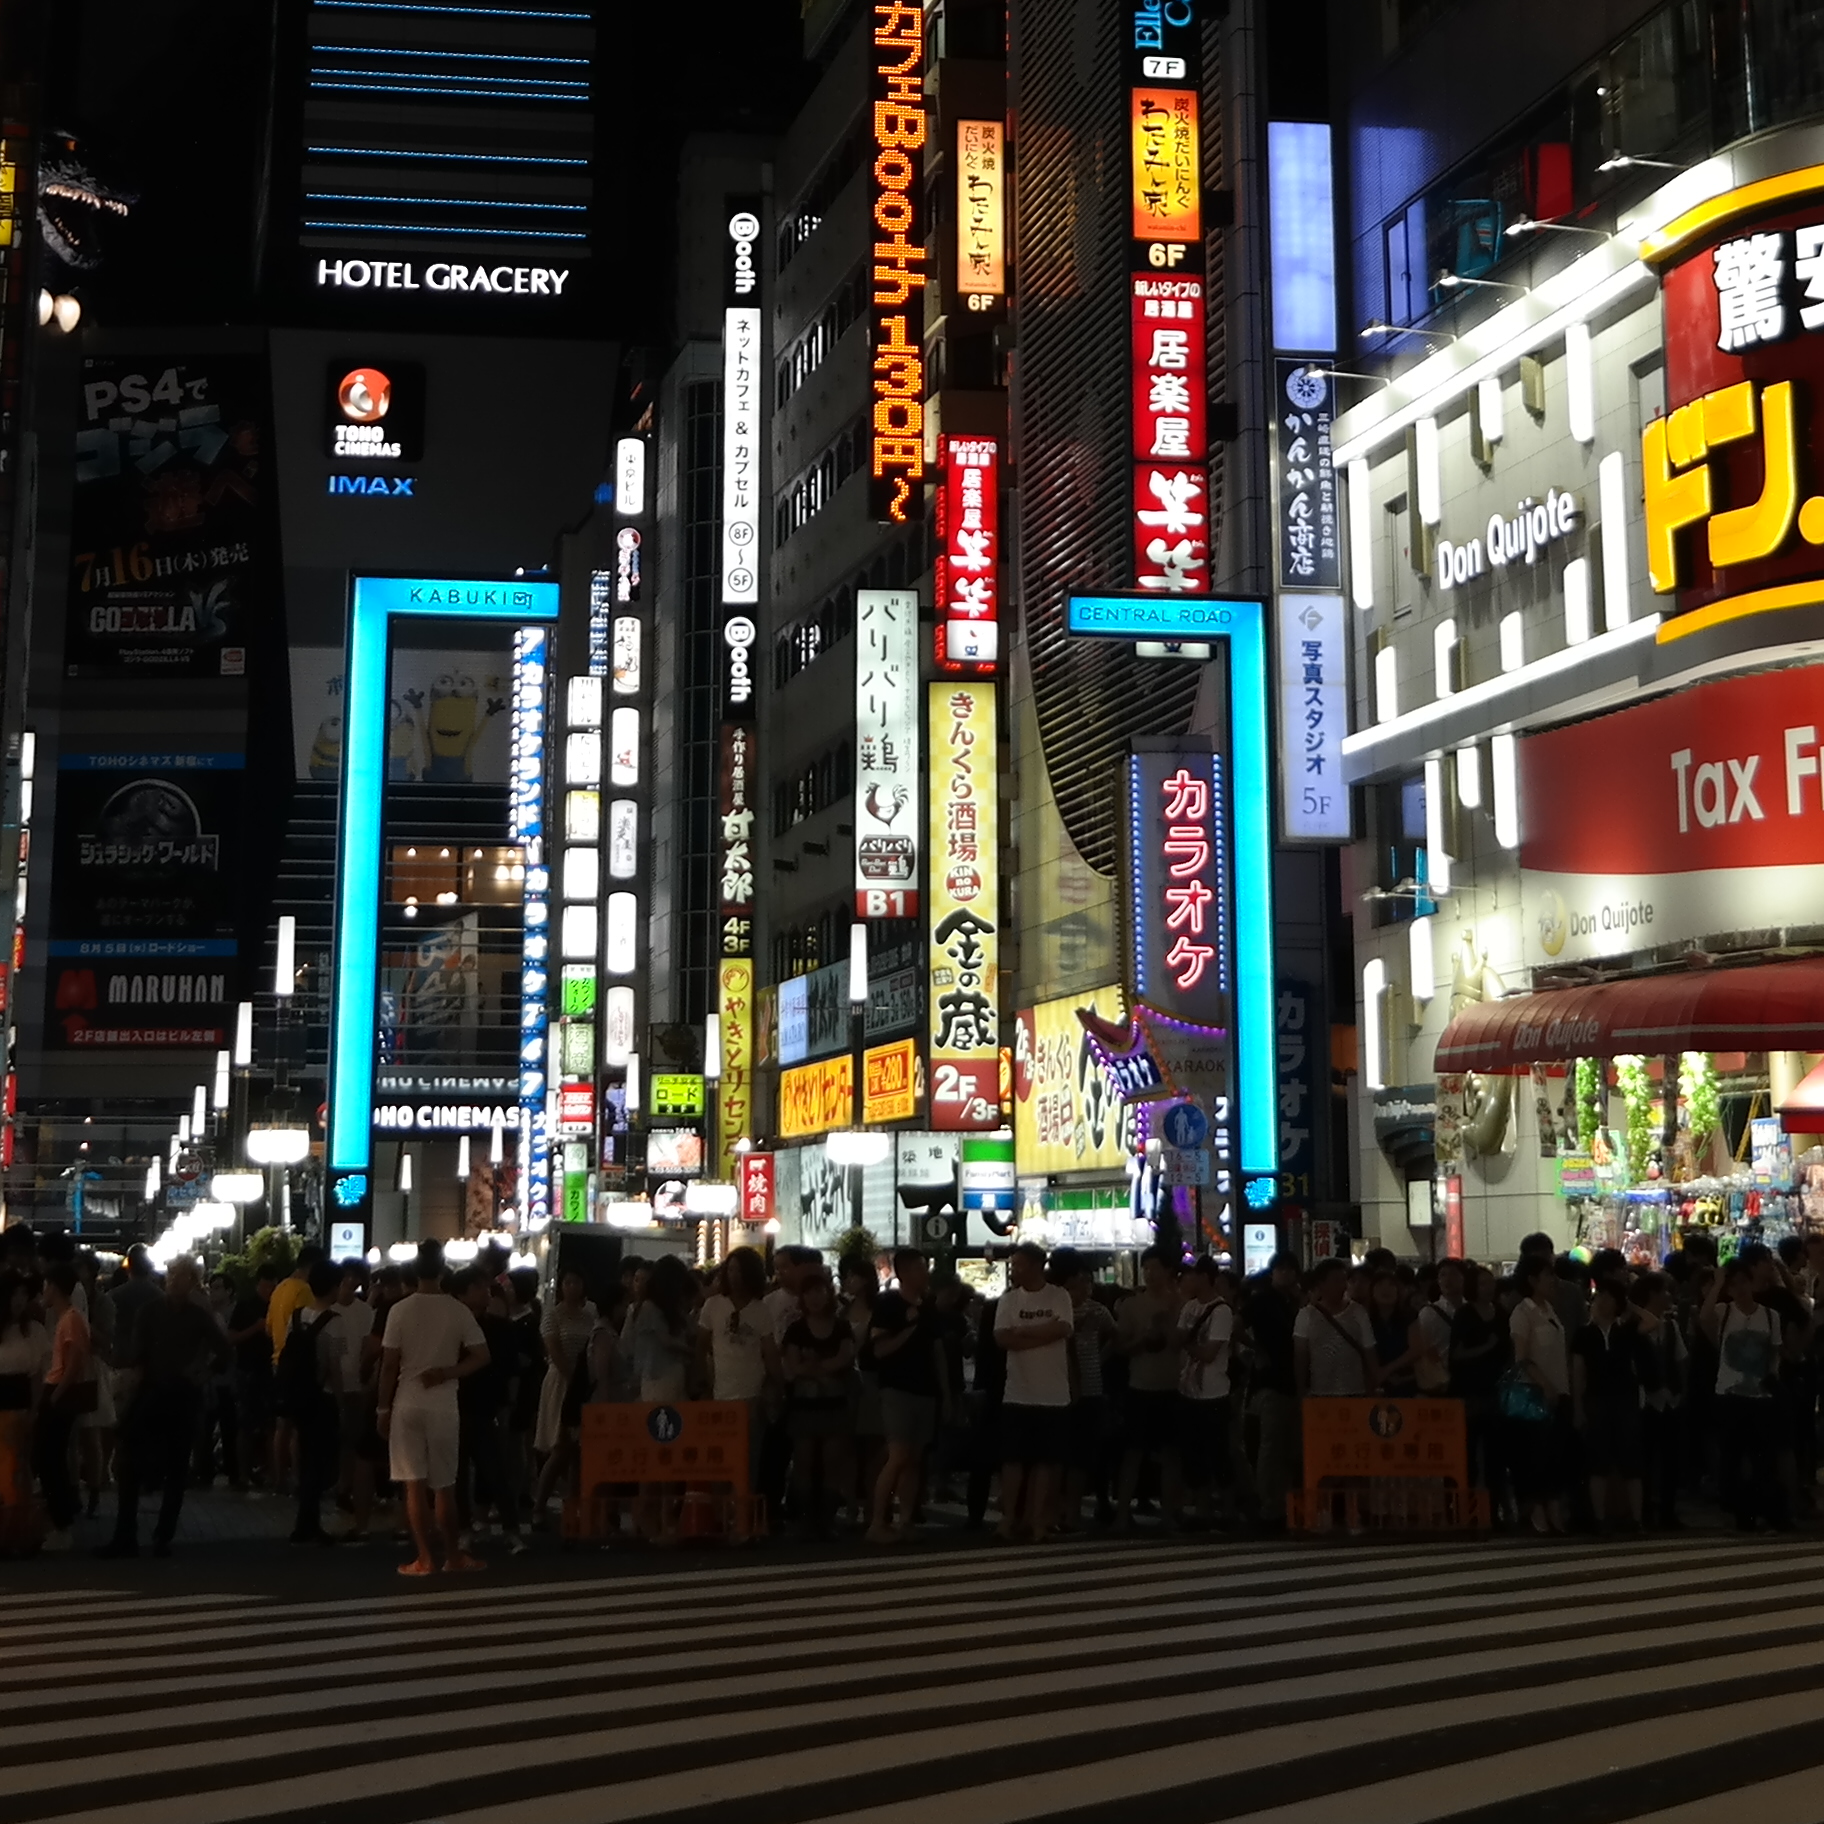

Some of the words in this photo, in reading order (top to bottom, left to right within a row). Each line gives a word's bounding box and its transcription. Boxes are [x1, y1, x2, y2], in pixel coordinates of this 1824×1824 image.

[1150, 60, 1179, 75] 7F
[1148, 244, 1186, 267] 6F
[318, 259, 420, 288] HOTEL
[425, 263, 569, 295] GRACERY
[1135, 279, 1201, 298] 新しいタイプの
[967, 294, 994, 312] 6F
[1148, 328, 1193, 458] 居楽屋
[335, 425, 384, 443] TOHO
[335, 442, 401, 457] CINEMAS
[328, 475, 414, 496] IMAX
[960, 467, 984, 530] 居楽屋
[1285, 413, 1315, 575] かんかん商店
[1437, 531, 1481, 593] Don
[1486, 488, 1575, 575] Quijote
[949, 530, 992, 617] 笑笑
[1078, 606, 1173, 624] CENTRAL
[1179, 608, 1233, 624] ROAD
[1302, 641, 1326, 776] 写真スタジオ
[947, 692, 977, 863] きんくら酒場
[1671, 742, 1765, 836] Tax
[1302, 787, 1332, 815] 5F
[722, 808, 753, 903] 甘太郎
[952, 866, 974, 877] KIN
[1163, 769, 1213, 990] カラオケ
[866, 890, 905, 917] B1
[1570, 910, 1596, 937] Don
[1601, 899, 1654, 932] Quijote
[723, 917, 750, 933] 4F
[723, 936, 750, 953] 3F
[108, 974, 225, 1003] MARUHAN
[934, 907, 997, 1050] 金の蔵
[1513, 1024, 1541, 1051] Don
[1545, 1016, 1600, 1051] Quijote
[1280, 991, 1309, 1162] カラオケ
[656, 1087, 698, 1101] ロード
[417, 1105, 520, 1128] CINEMAS
[748, 1175, 766, 1213] 焼肉
